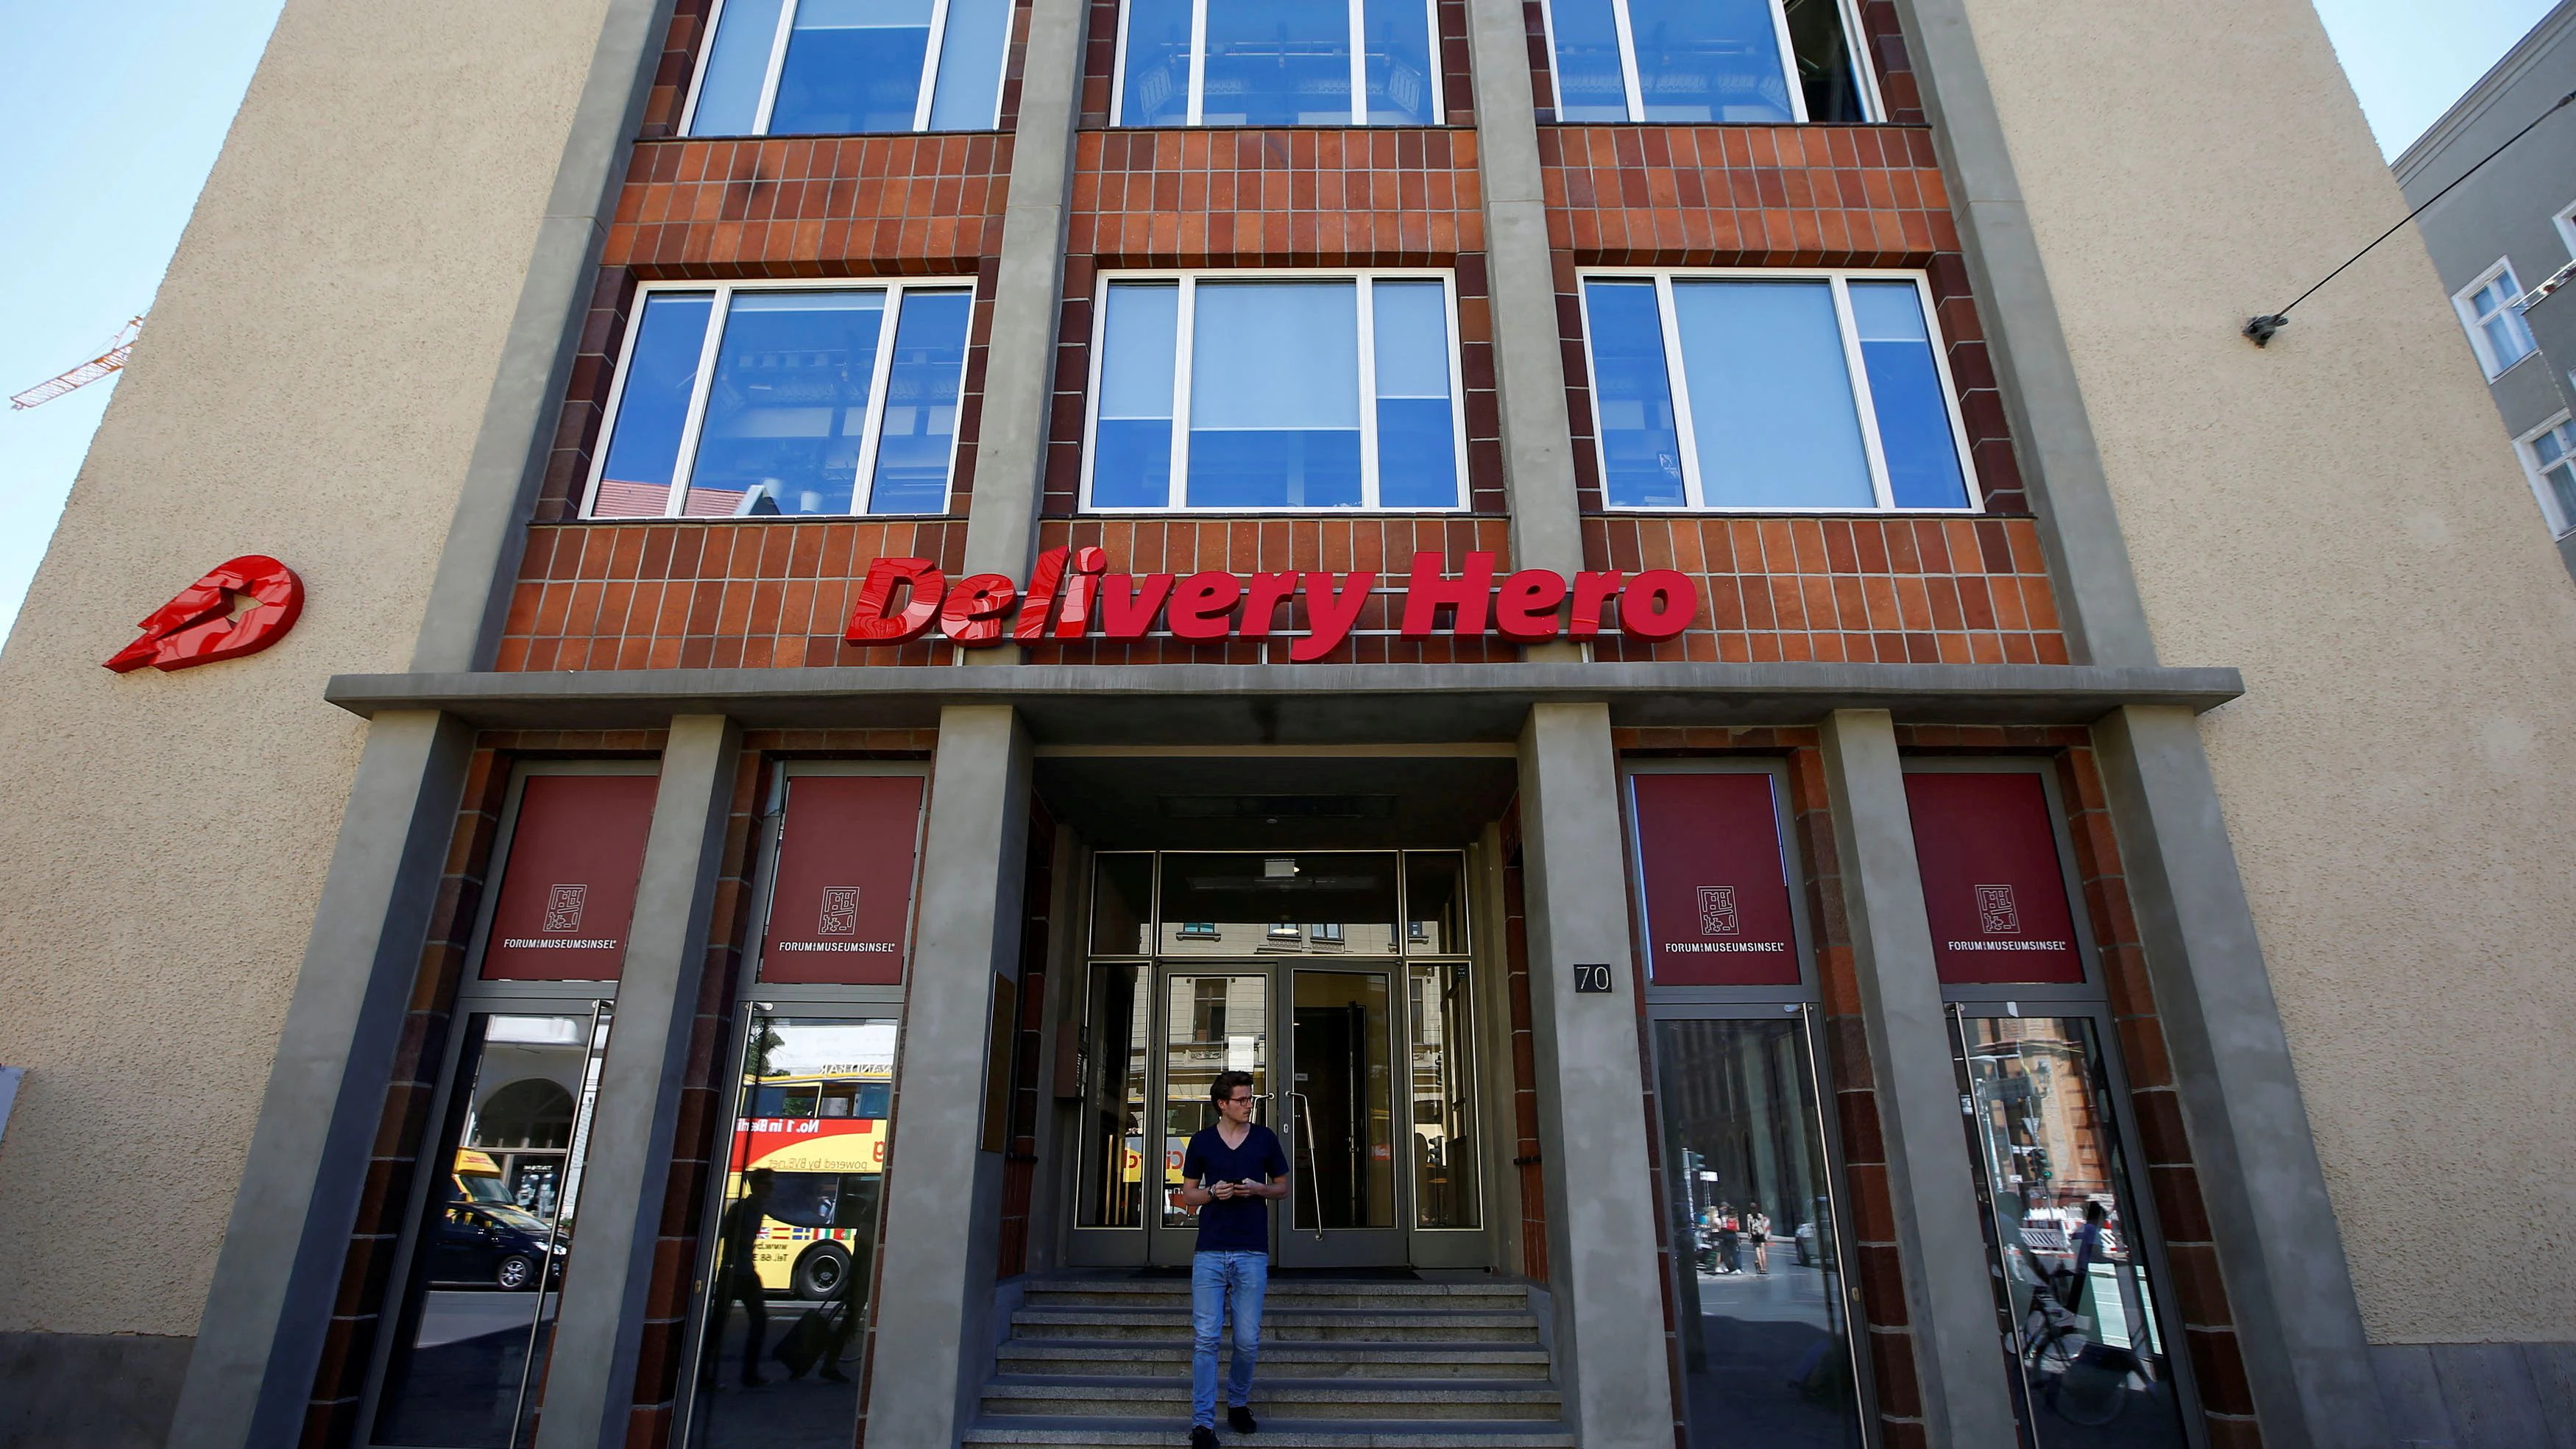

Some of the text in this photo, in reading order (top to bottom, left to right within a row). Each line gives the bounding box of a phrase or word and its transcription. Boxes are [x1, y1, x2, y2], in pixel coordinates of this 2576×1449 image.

[845, 545, 1697, 662] Delivery Hero
[1577, 966, 1609, 990] 70
